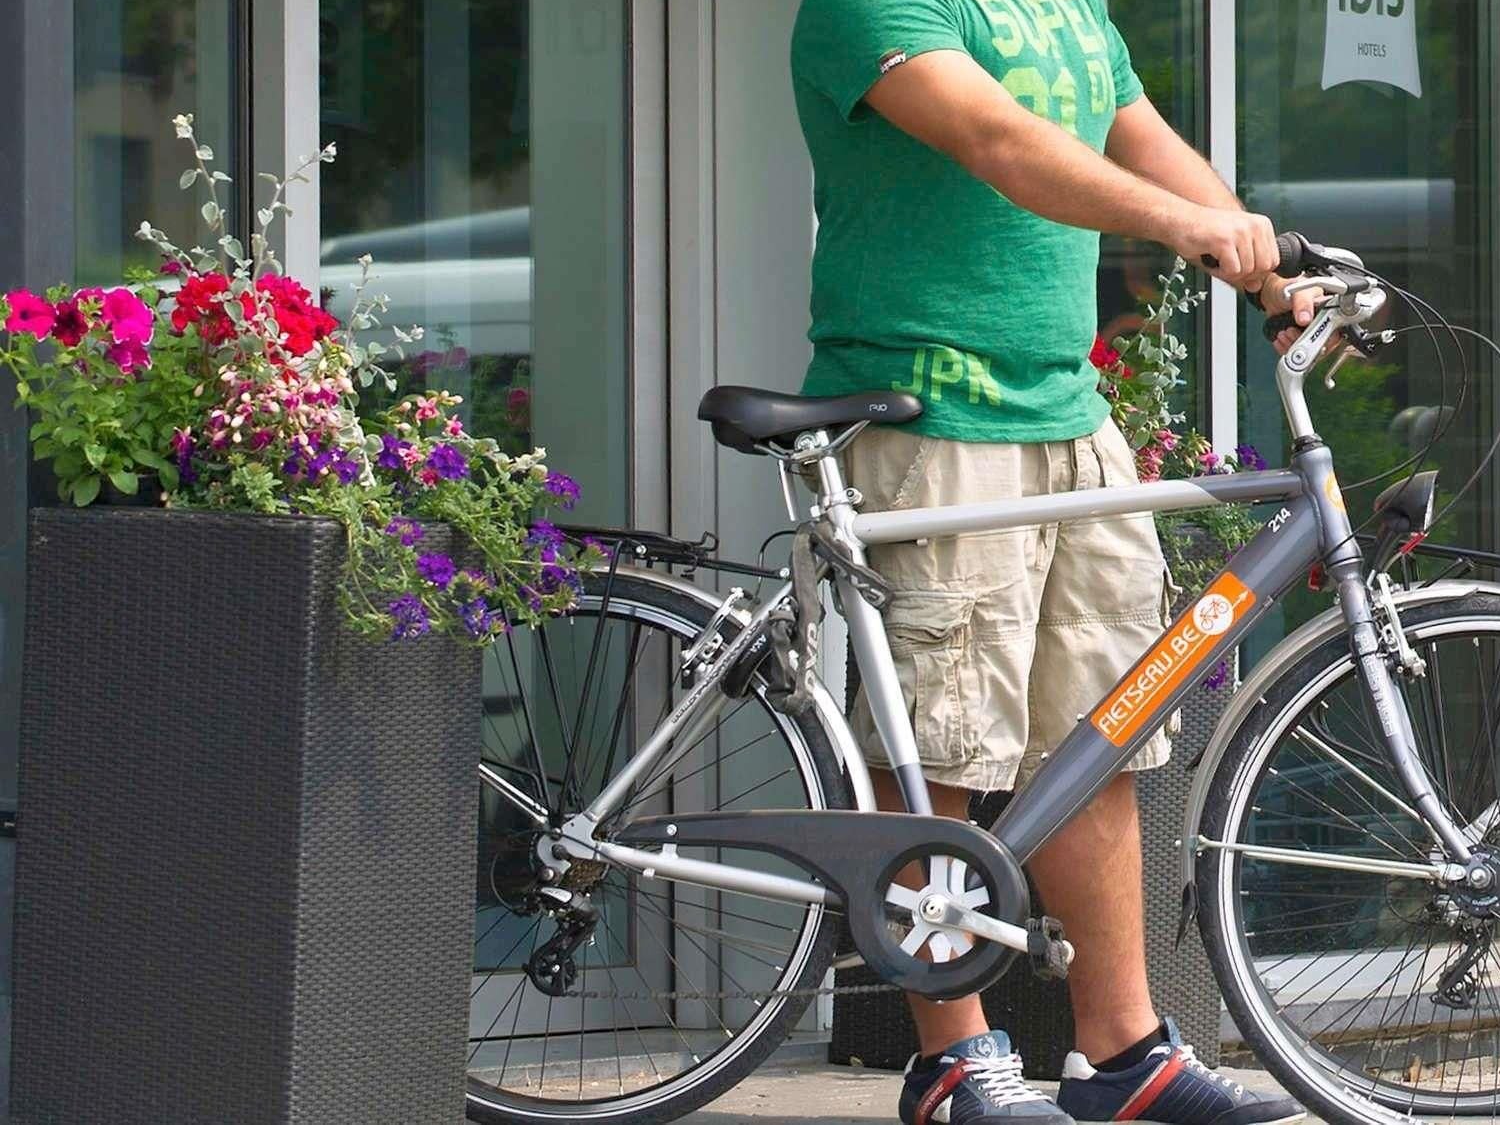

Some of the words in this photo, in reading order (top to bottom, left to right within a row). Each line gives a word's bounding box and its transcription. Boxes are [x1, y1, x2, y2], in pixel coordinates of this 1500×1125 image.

[1357, 42, 1387, 58] HOTELS
[891, 346, 1001, 407] JPN
[1267, 507, 1292, 533] 214
